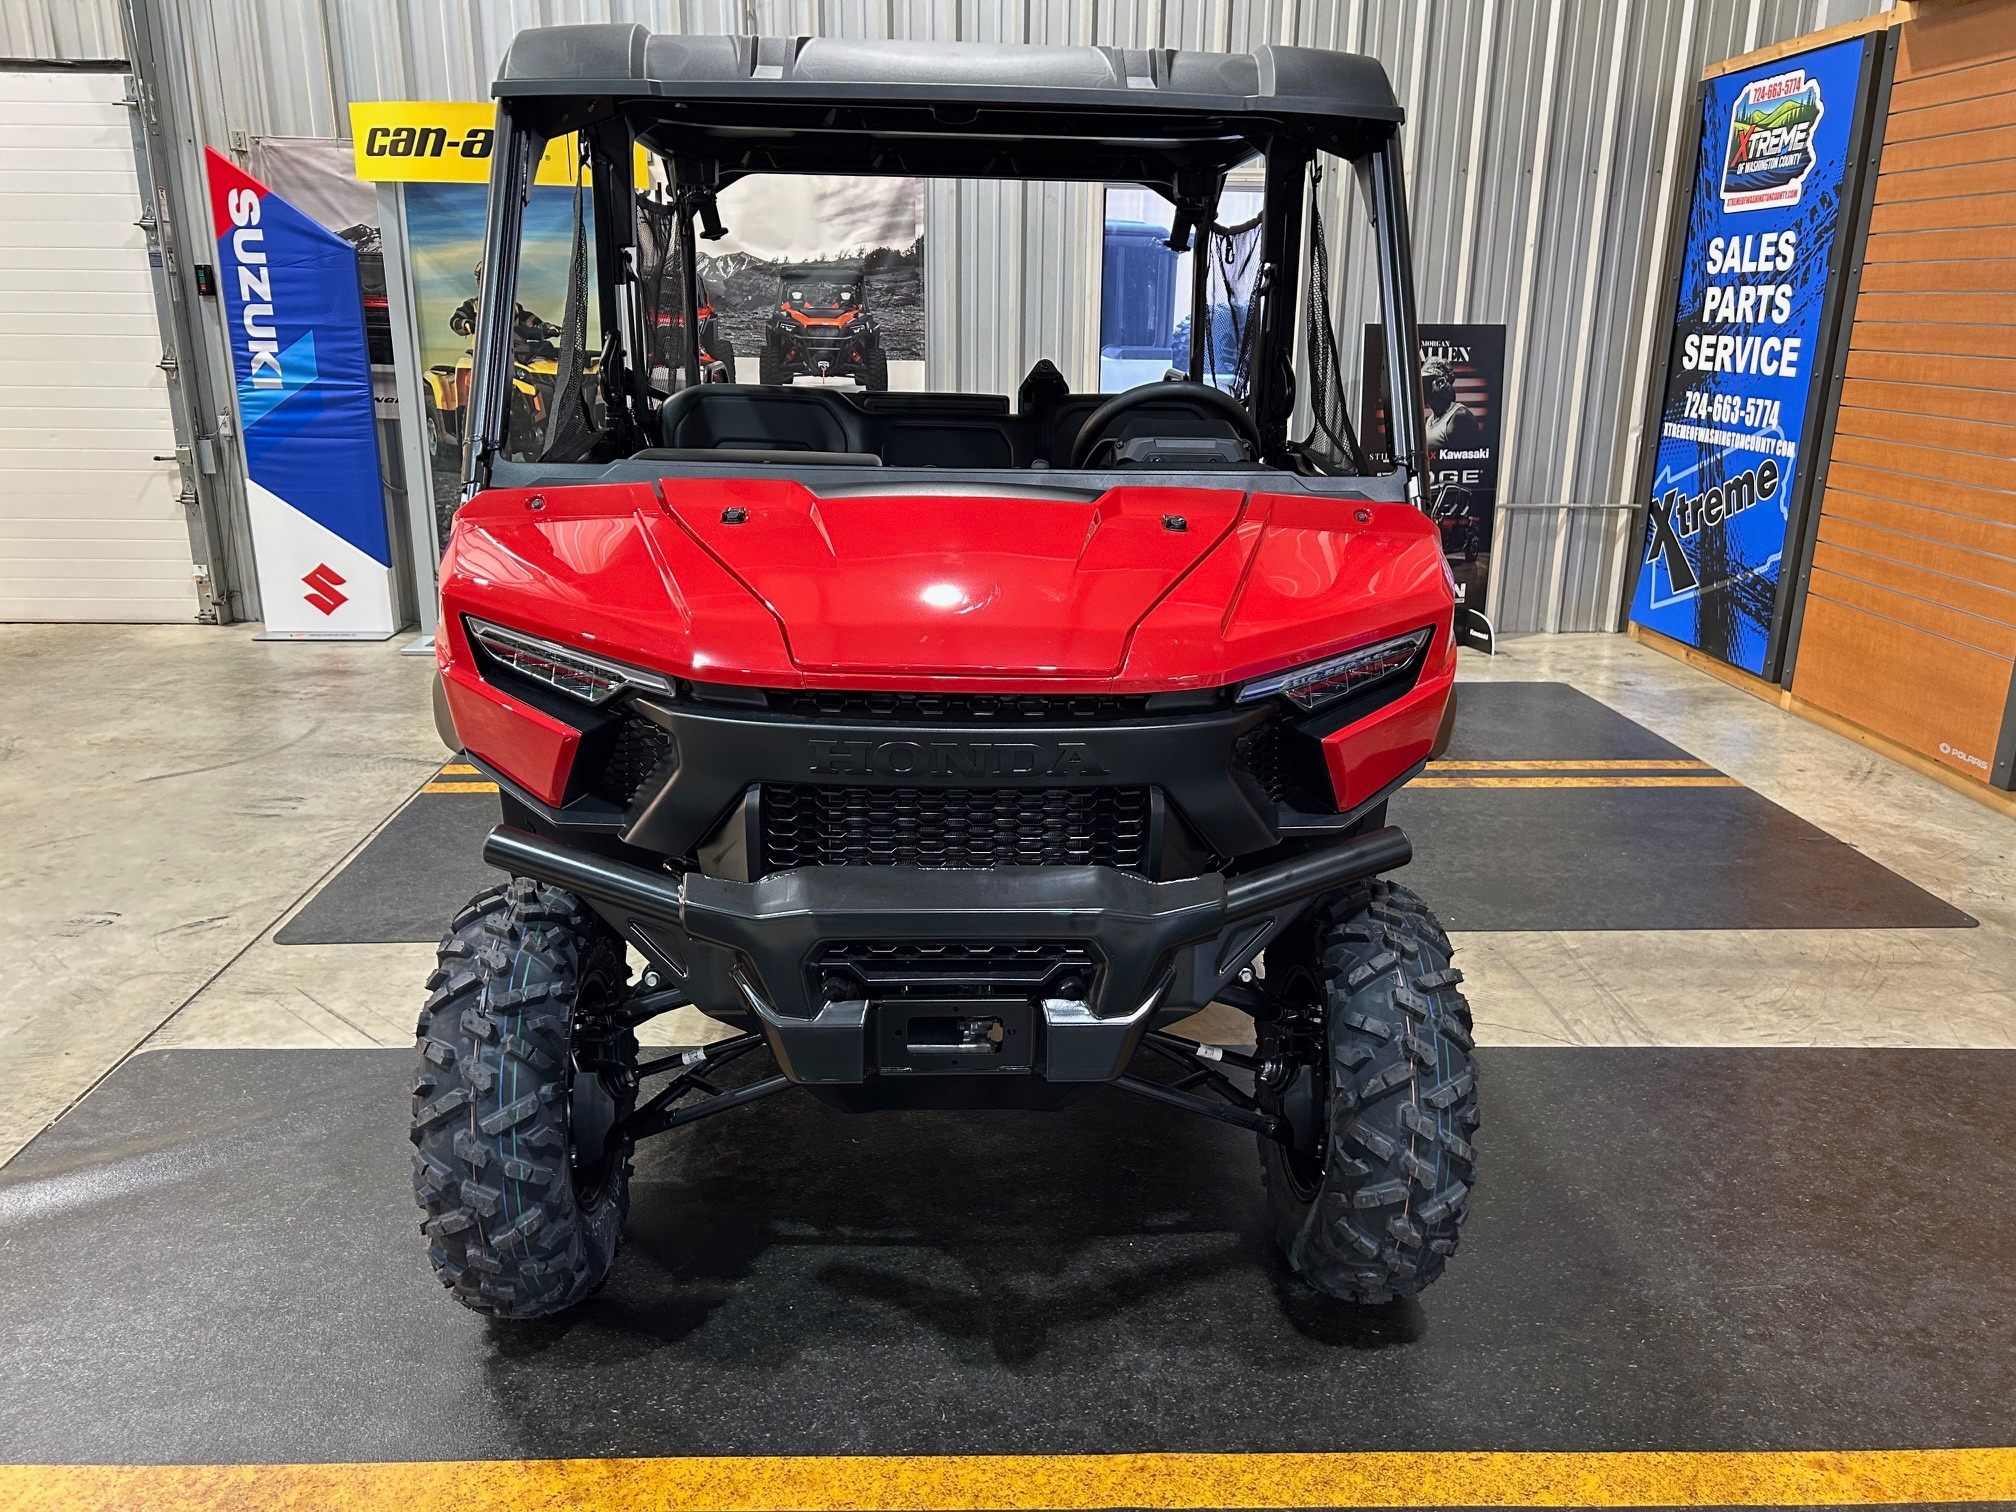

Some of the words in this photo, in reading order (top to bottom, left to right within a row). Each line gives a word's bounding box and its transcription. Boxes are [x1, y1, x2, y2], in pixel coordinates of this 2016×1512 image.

[1753, 77, 1802, 102] 724-663-5774
[366, 127, 494, 158] can-a
[1730, 124, 1810, 168] XTREME
[1736, 162, 1747, 175] OF
[1744, 156, 1779, 174] WASHINGTON
[1778, 152, 1802, 169] COUNTY
[1706, 230, 1797, 275] SALES
[228, 188, 284, 389] SUZUKI
[1702, 284, 1793, 324] PARTS
[1419, 346, 1471, 362] ALLEN
[1682, 333, 1802, 378] SERVICE
[1683, 390, 1781, 430] 724-663-5774
[1369, 452, 1389, 461] STIL
[1439, 447, 1490, 460] Kawasaki
[1645, 458, 1780, 595] Xtreme
[808, 739, 1110, 777] HONDA
[1951, 748, 1988, 770] POLARIS
